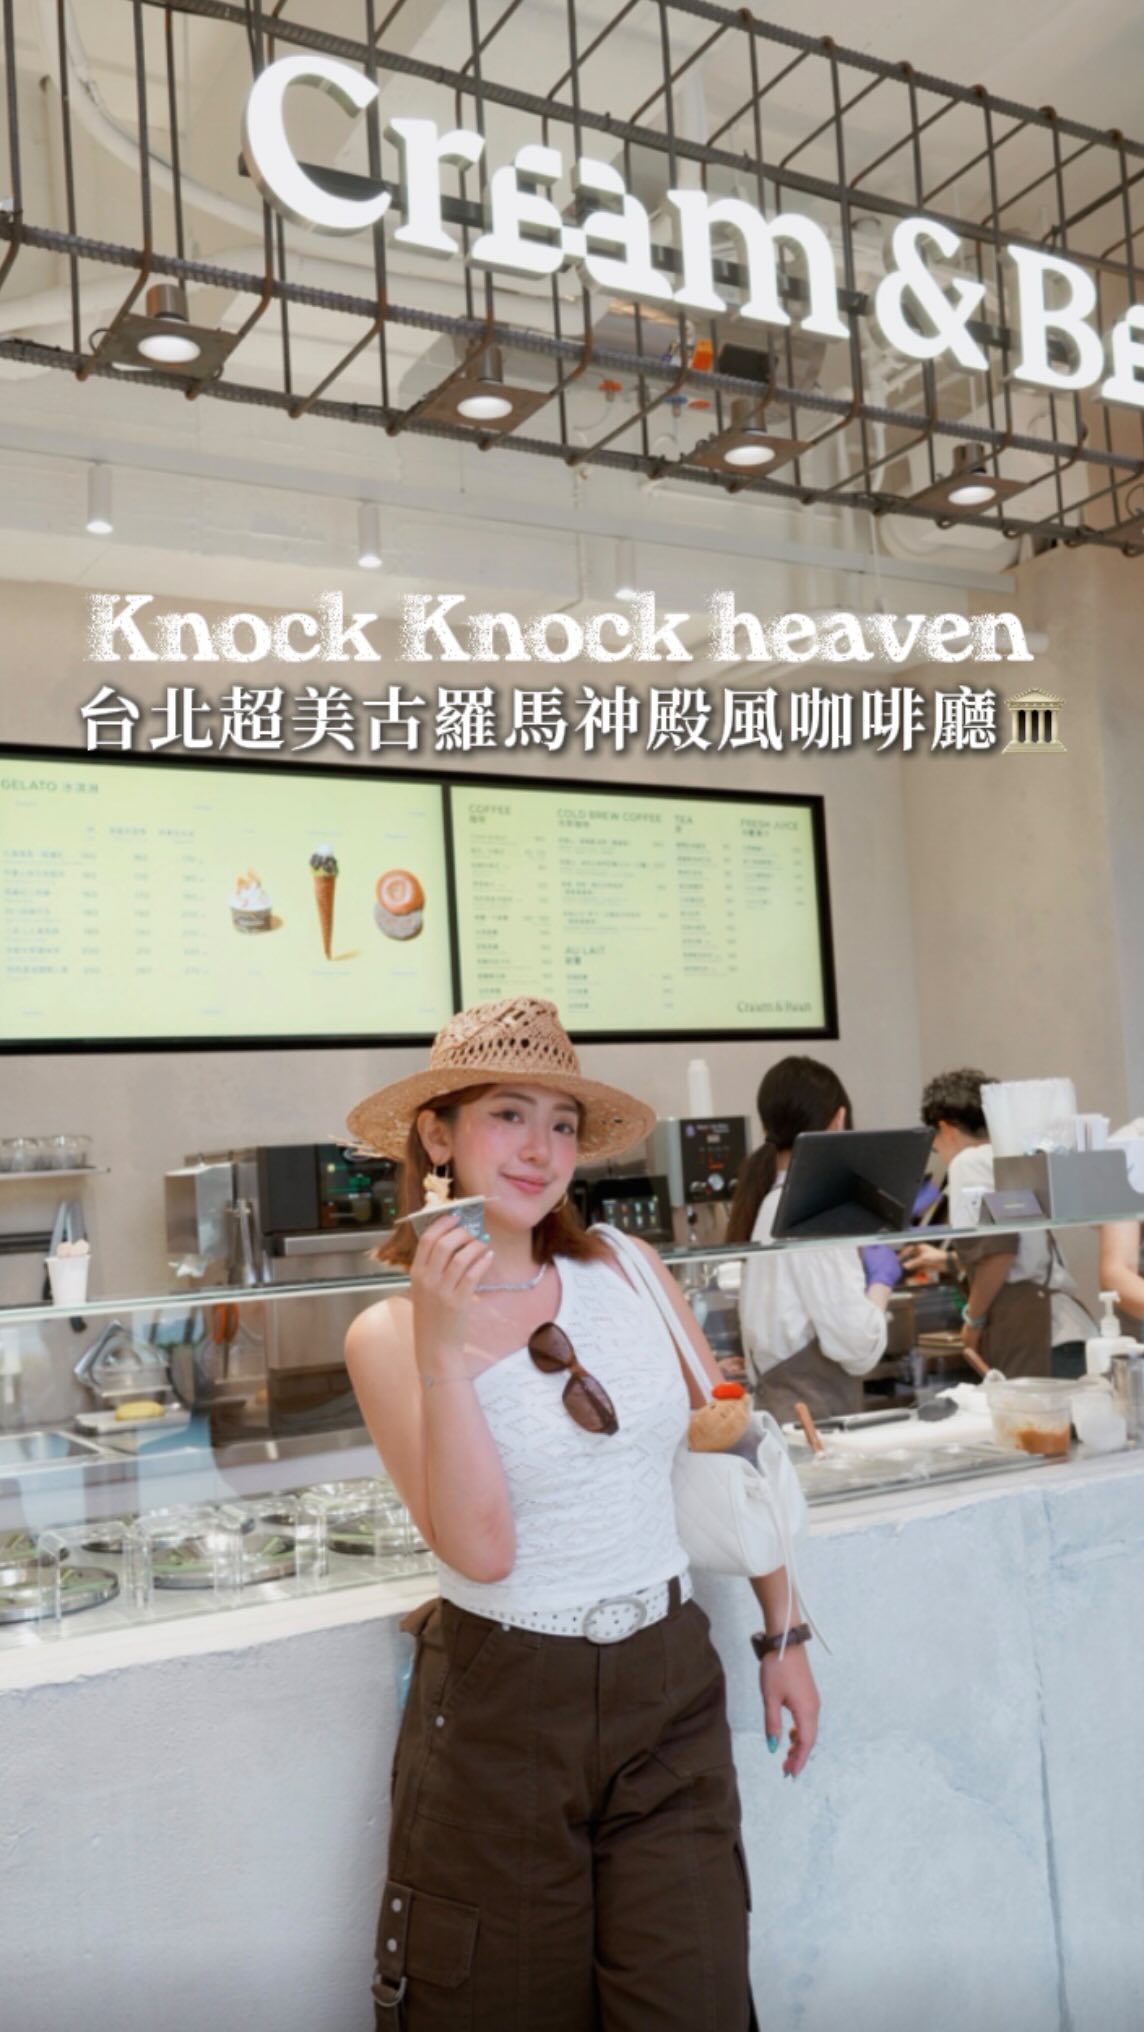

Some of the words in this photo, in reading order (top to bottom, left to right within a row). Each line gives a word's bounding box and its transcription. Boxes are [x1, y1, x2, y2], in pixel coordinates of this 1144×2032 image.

[241, 53, 853, 342] Cream
[874, 217, 990, 372] &
[0, 779, 58, 792] GELATO
[468, 804, 511, 816] COFFEE
